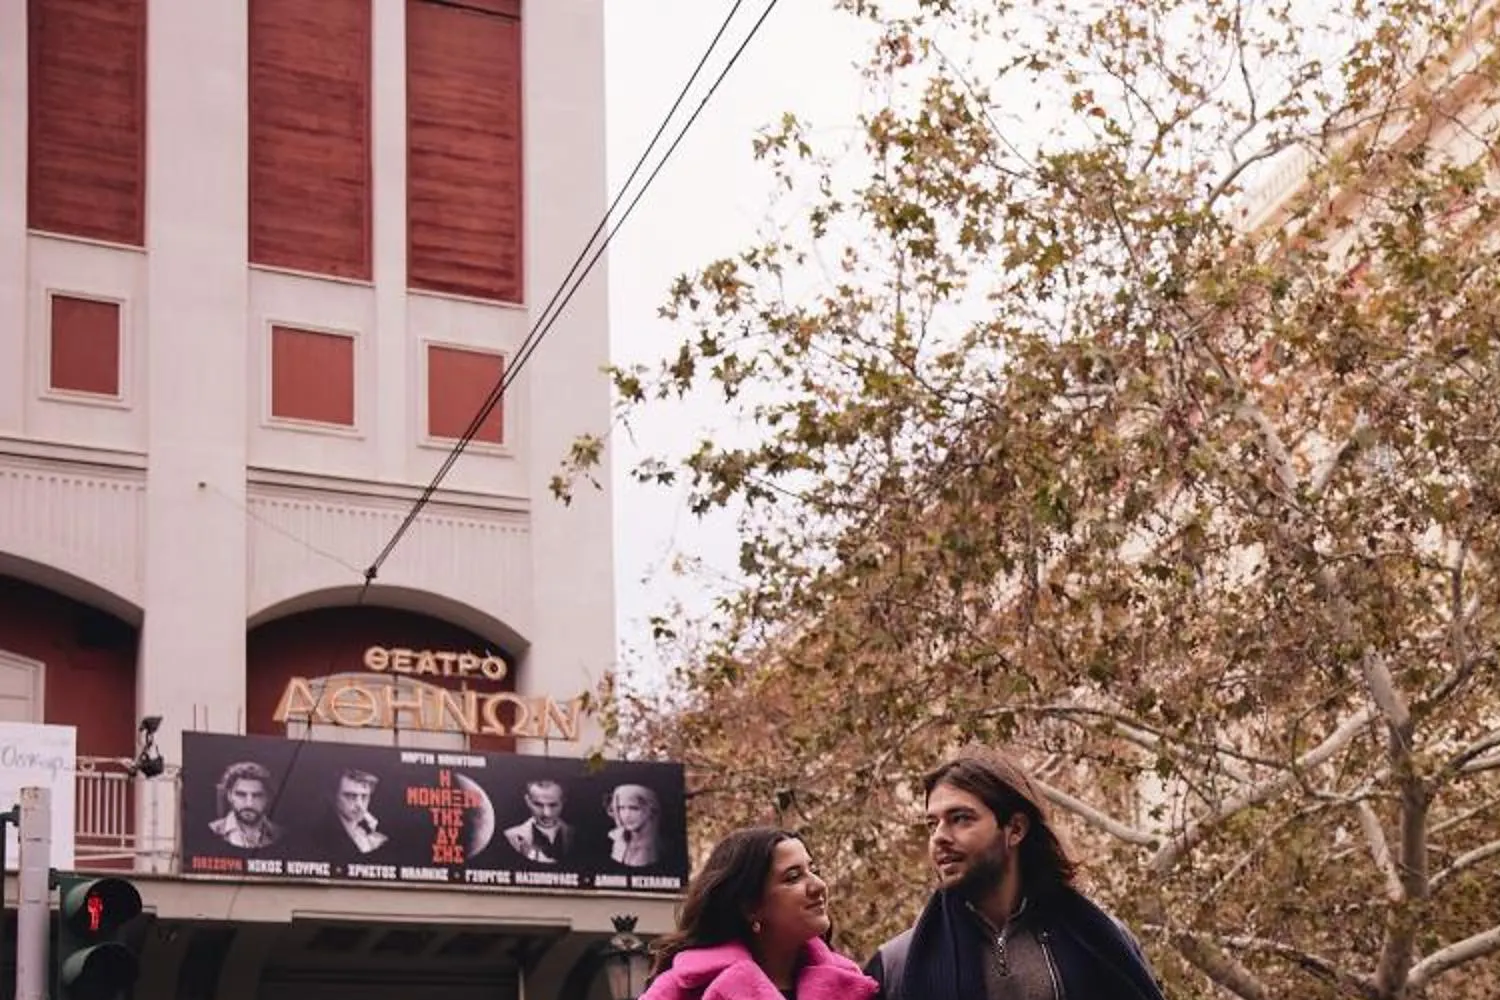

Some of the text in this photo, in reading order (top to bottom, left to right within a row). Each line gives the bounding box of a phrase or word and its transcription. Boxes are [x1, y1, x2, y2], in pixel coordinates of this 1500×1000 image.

[364, 645, 507, 680] ΘΕΑΤΡΟ
[272, 676, 583, 741] ΑΘΗΝΩΝ
[430, 806, 464, 827] ΤΗΣ
